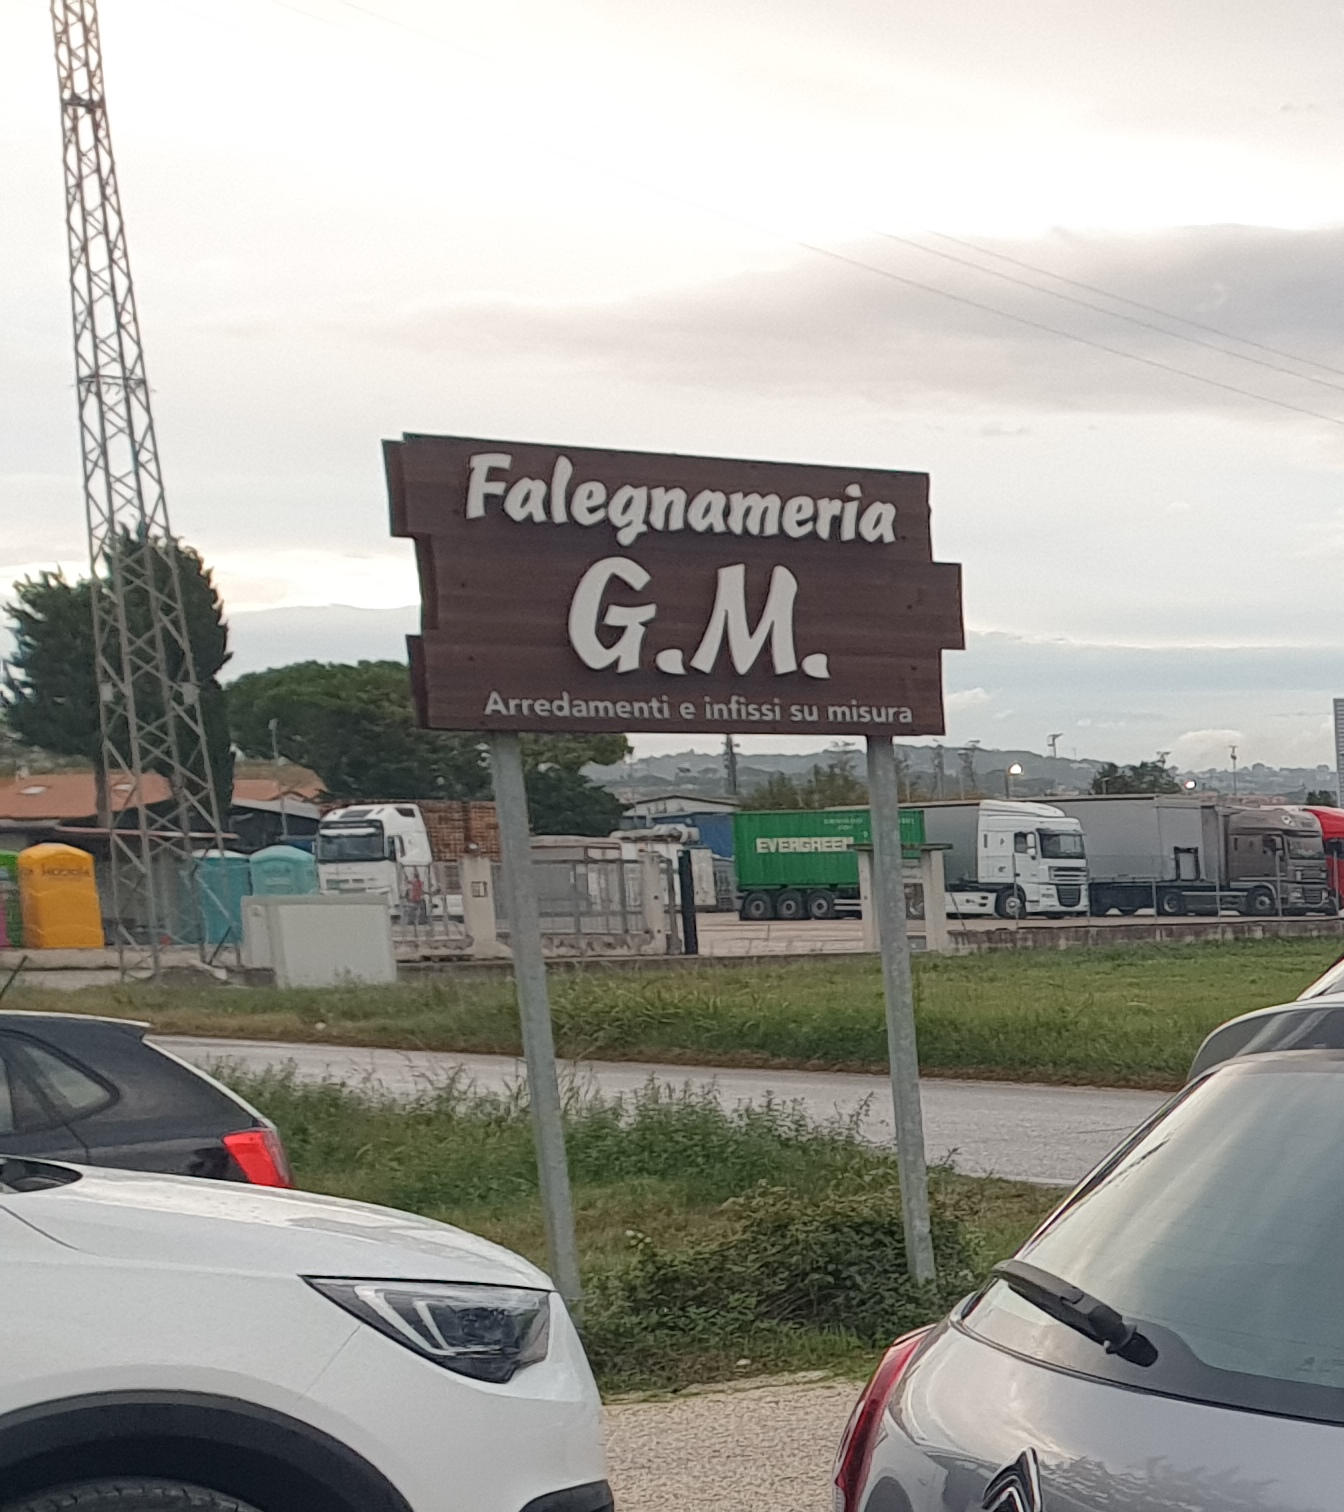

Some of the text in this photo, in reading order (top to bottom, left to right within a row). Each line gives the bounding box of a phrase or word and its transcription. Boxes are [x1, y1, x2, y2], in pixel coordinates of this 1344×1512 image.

[466, 452, 896, 546] Falegnameria
[568, 556, 830, 679] G.M.
[484, 691, 913, 724] Arredamenti e infissi su misura
